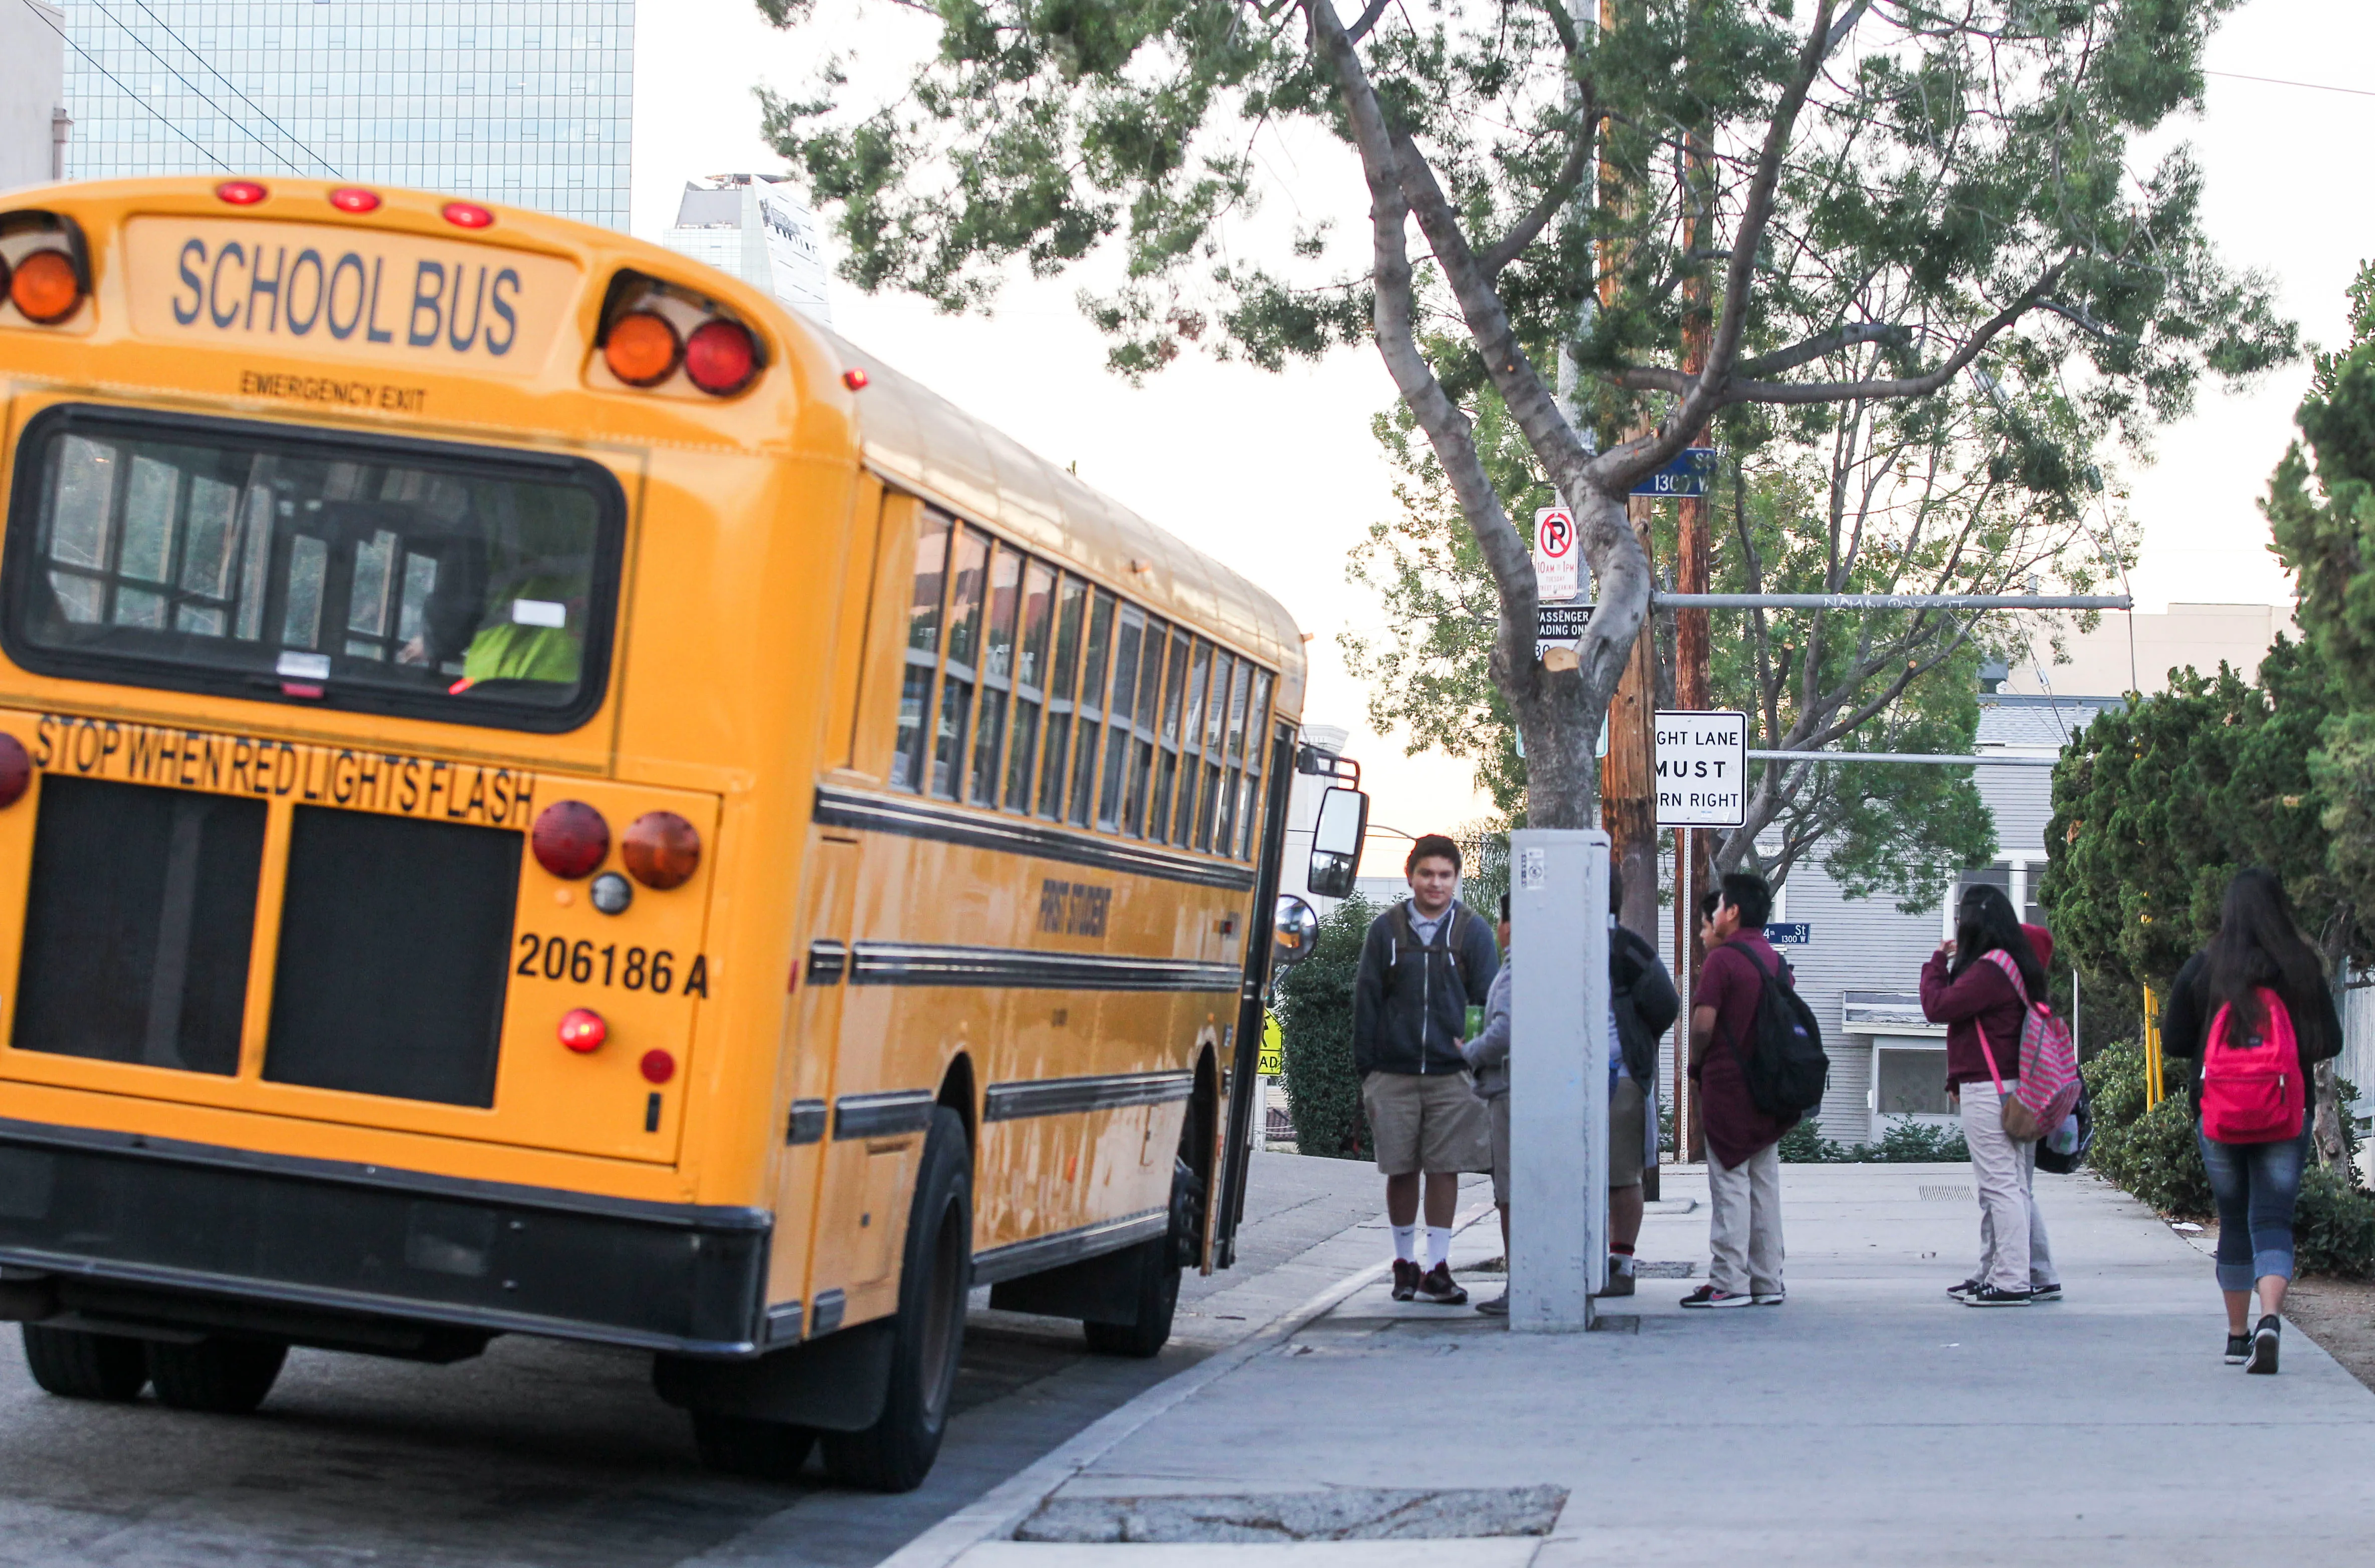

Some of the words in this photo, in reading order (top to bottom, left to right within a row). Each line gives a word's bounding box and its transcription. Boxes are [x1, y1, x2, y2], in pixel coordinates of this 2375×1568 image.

[173, 239, 391, 343] SCHOOL
[409, 261, 520, 355] BUS
[241, 370, 377, 405] EMERGENCY
[380, 385, 427, 412] EXIT
[1537, 561, 1554, 573] 10AM
[1563, 560, 1574, 572] 1PM
[1537, 611, 1589, 622] ASSENGER
[1539, 625, 1568, 635] ADING
[1571, 625, 1587, 635] ON
[1657, 731, 1688, 745] GHT
[1696, 732, 1738, 745] LANE
[36, 714, 120, 773] STOP
[129, 725, 225, 789] WHEN
[231, 734, 297, 796] RED
[304, 746, 421, 811] LIGHTS
[426, 761, 535, 826] FLASH
[1656, 760, 1726, 777] MUST
[1656, 793, 1681, 807] RN
[1691, 794, 1738, 807] RIGHT
[1795, 924, 1806, 935] St
[517, 933, 673, 994] 206186
[683, 953, 708, 999] A
